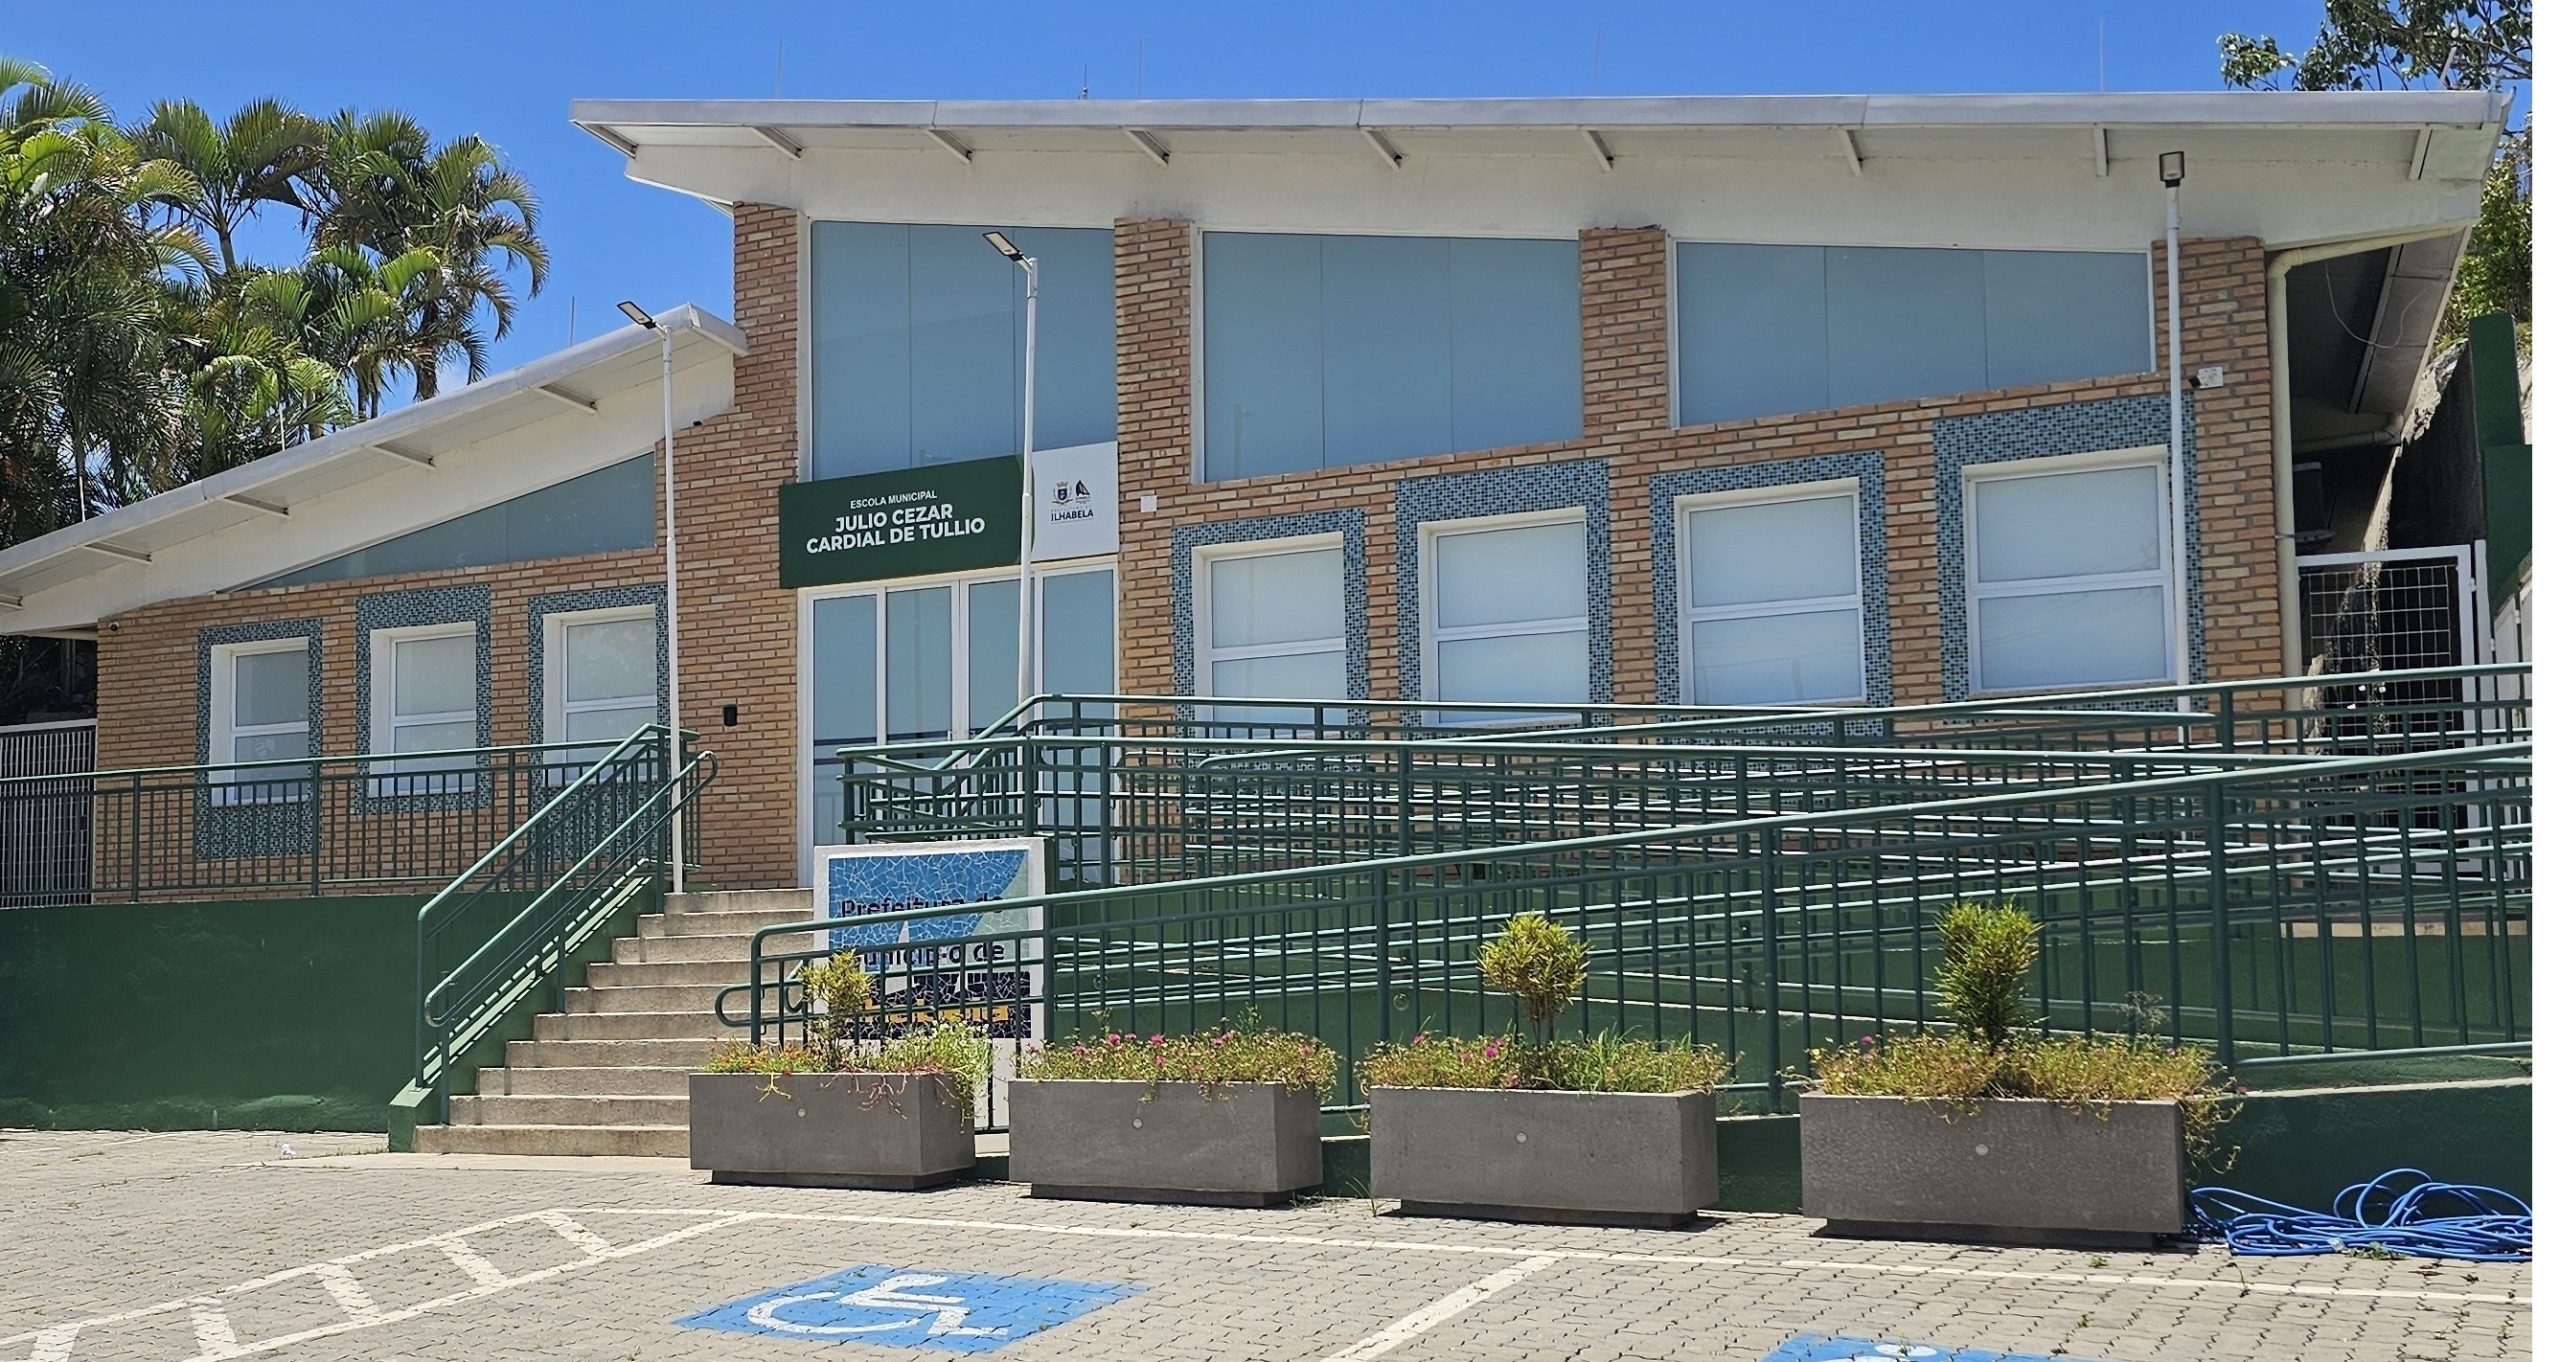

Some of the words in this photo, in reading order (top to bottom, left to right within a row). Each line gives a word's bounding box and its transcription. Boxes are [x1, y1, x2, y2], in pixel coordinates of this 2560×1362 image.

[850, 497, 887, 510] ESCOLA
[888, 490, 938, 504] MUNICIPAL
[835, 512, 888, 533] JULIO
[892, 503, 954, 526] CEZAR
[1051, 509, 1094, 522] ILHABELA
[806, 530, 886, 554] CARDIAL
[889, 526, 915, 544] DE
[919, 517, 986, 540] TULLIO
